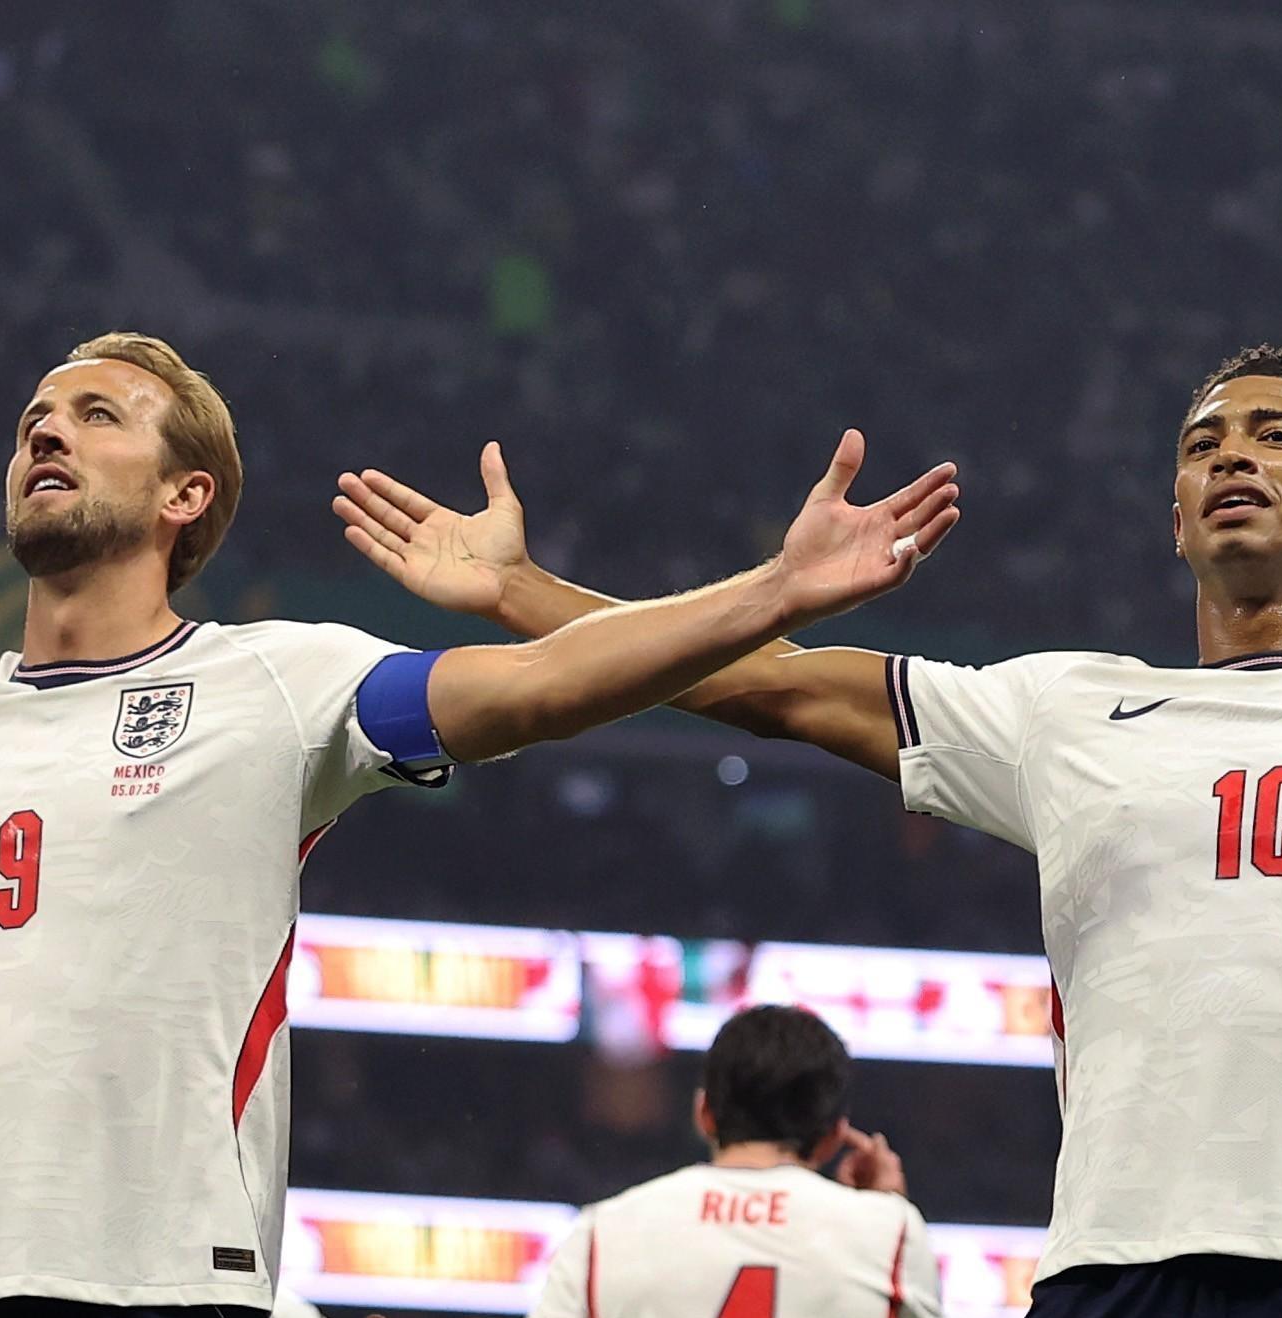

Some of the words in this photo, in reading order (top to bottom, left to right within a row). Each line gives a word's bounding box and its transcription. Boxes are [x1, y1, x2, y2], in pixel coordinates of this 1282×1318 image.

[113, 764, 166, 779] MEXICO
[110, 782, 161, 797] 05.07.26
[700, 1190, 790, 1225] RICE
